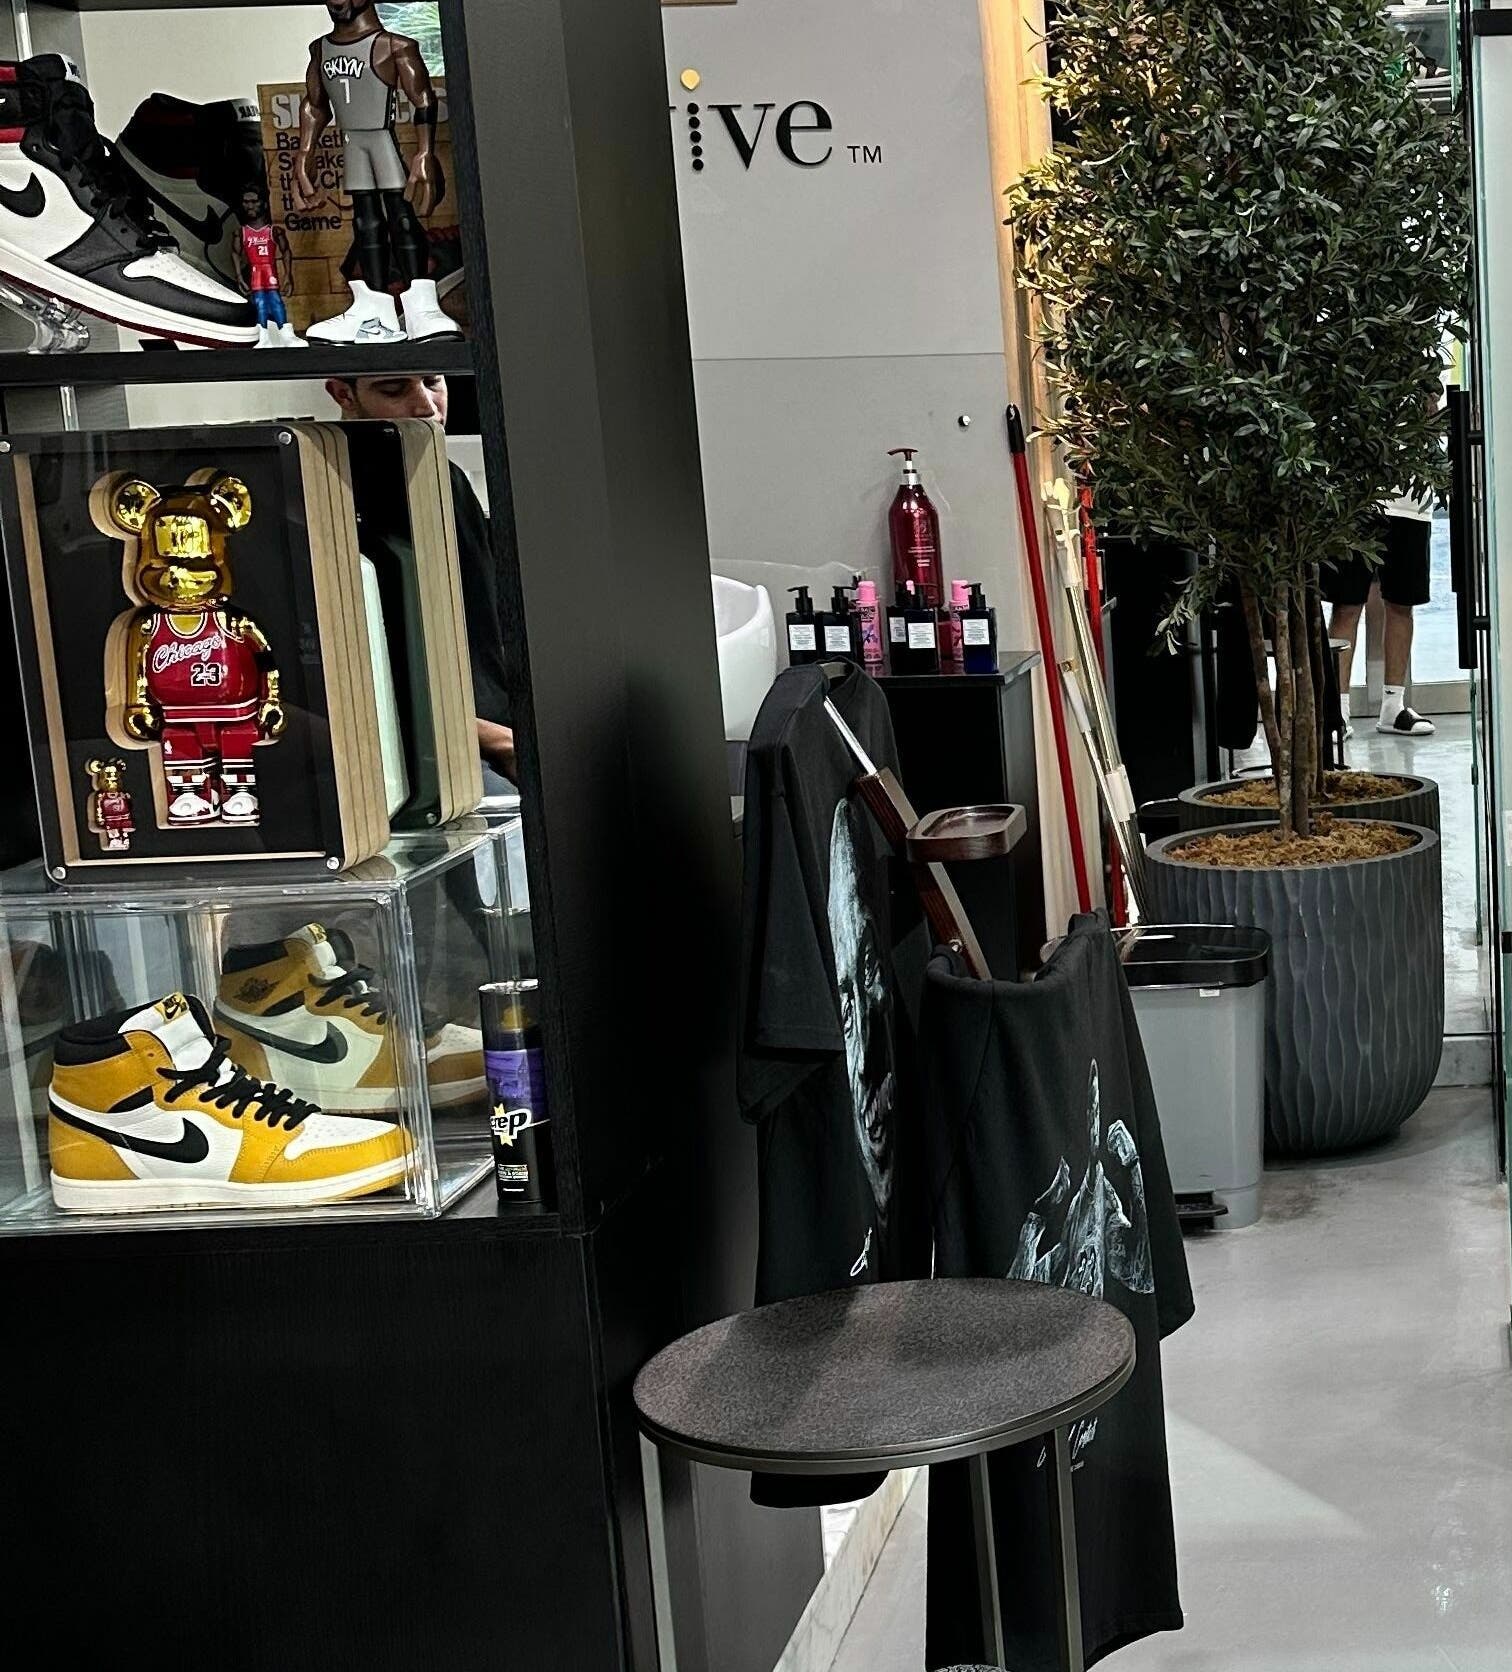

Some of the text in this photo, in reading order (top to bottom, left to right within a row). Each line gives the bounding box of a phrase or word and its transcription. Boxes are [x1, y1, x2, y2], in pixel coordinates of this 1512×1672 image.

[323, 56, 365, 79] BKLYN
[672, 68, 833, 171] ive
[284, 213, 342, 231] Game
[152, 633, 222, 674] Chicago
[190, 662, 222, 687] 23
